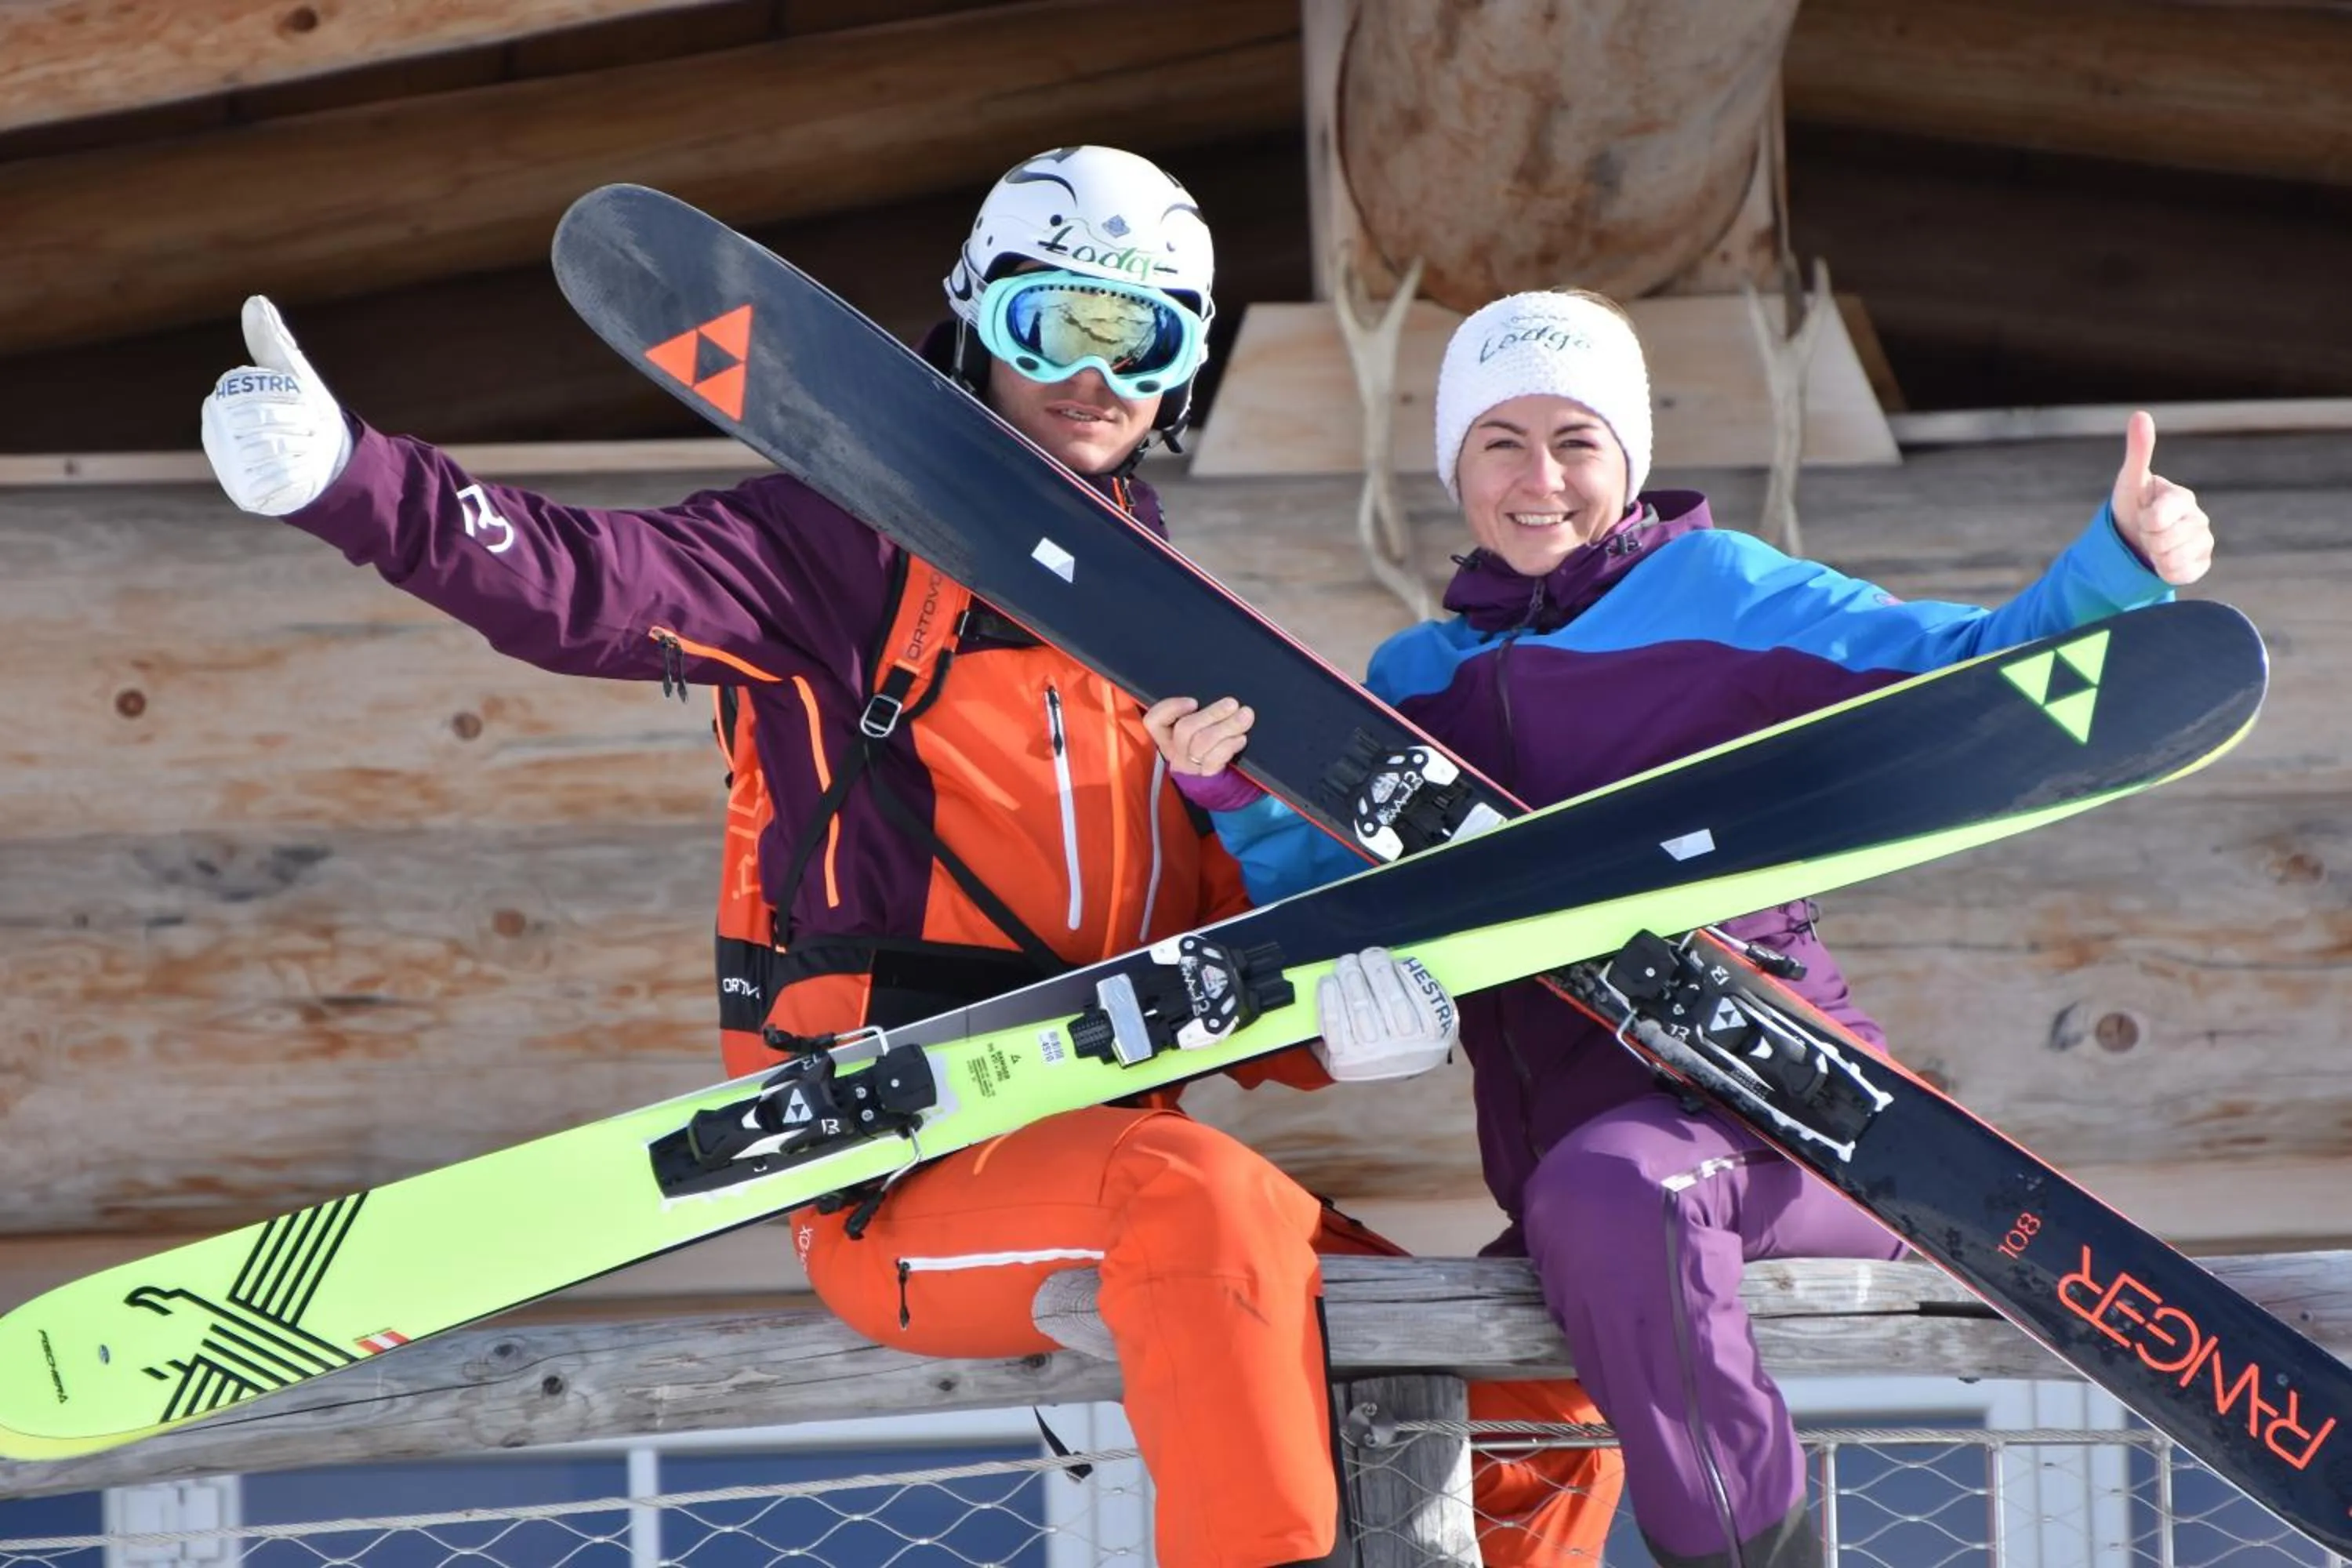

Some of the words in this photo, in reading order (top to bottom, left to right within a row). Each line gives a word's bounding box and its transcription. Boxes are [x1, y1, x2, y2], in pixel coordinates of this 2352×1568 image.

[216, 376, 301, 401] HESTRA
[1403, 957, 1454, 1039] HESTRA
[1996, 1212, 2042, 1260] 108
[2056, 1244, 2337, 1471] RANGER
